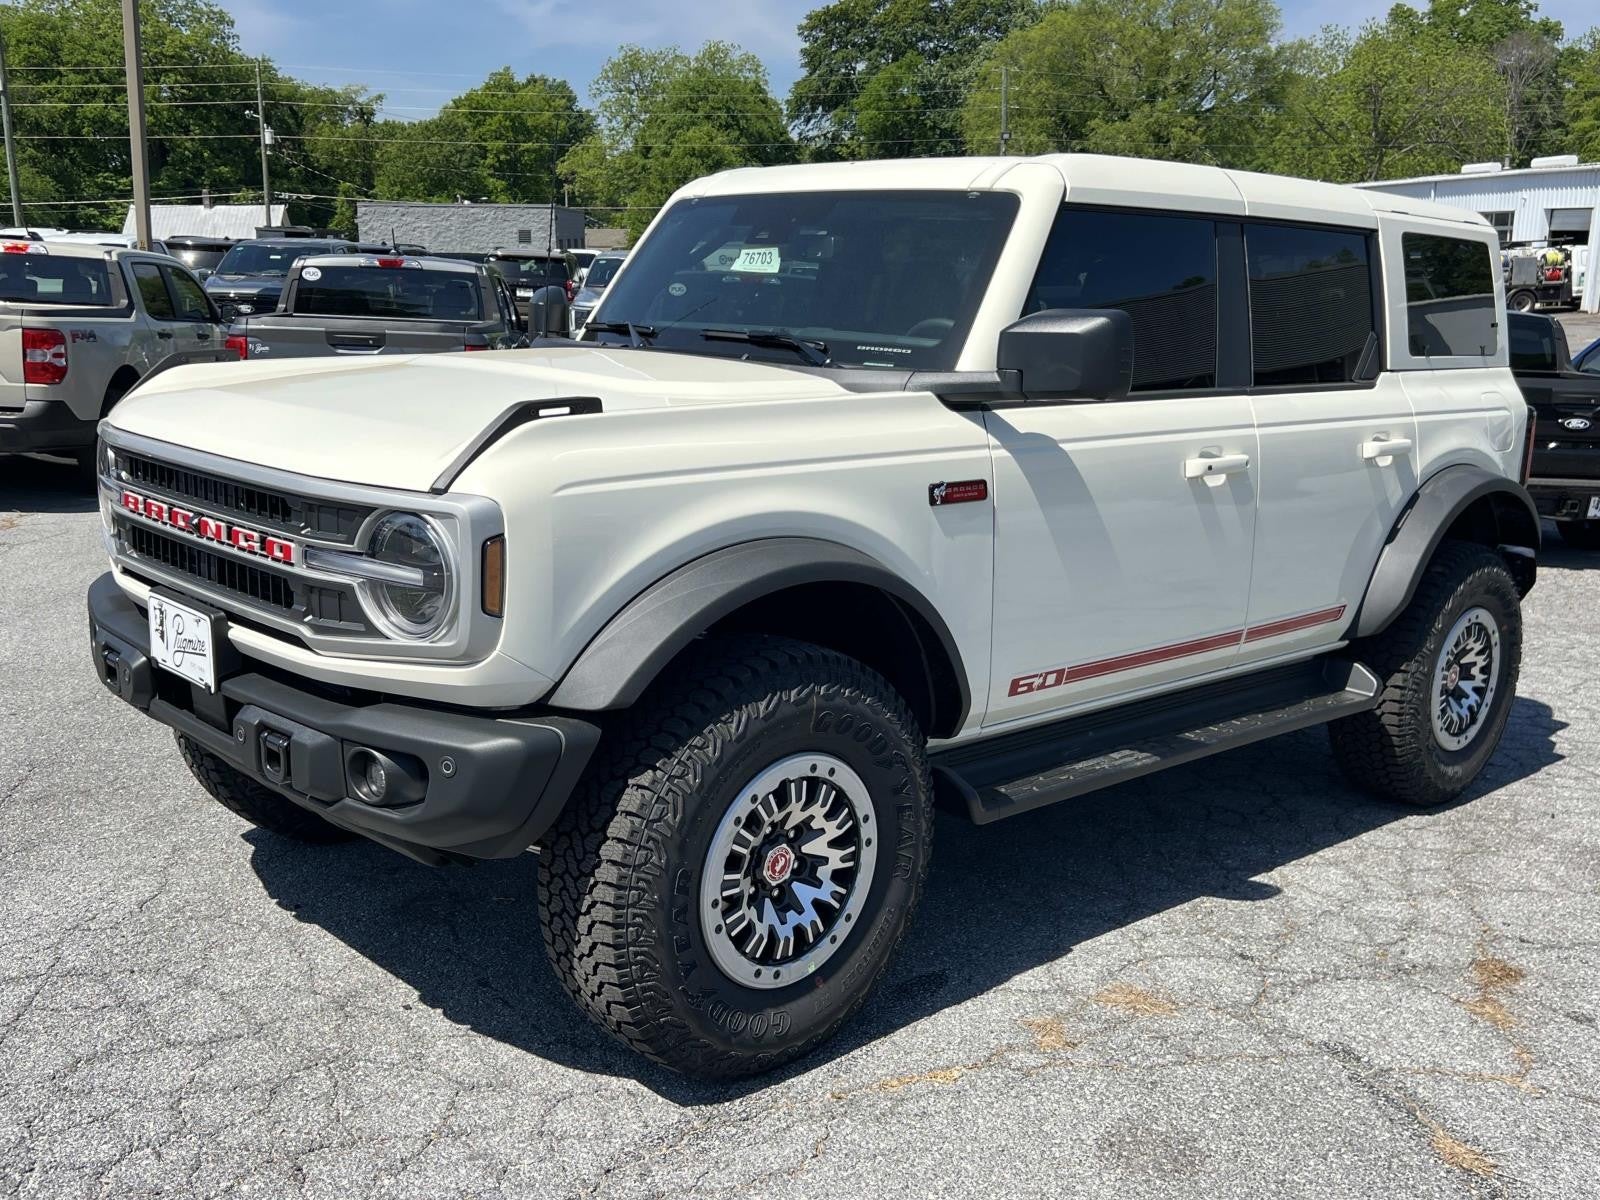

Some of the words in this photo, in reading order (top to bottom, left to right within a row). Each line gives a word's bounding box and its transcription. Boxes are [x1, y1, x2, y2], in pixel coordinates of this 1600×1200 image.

[743, 251, 773, 265] 76703
[857, 345, 912, 354] BRONCO
[123, 491, 297, 566] BRONCO
[173, 614, 207, 668] Pugmire
[814, 709, 914, 880] GOODYEAR
